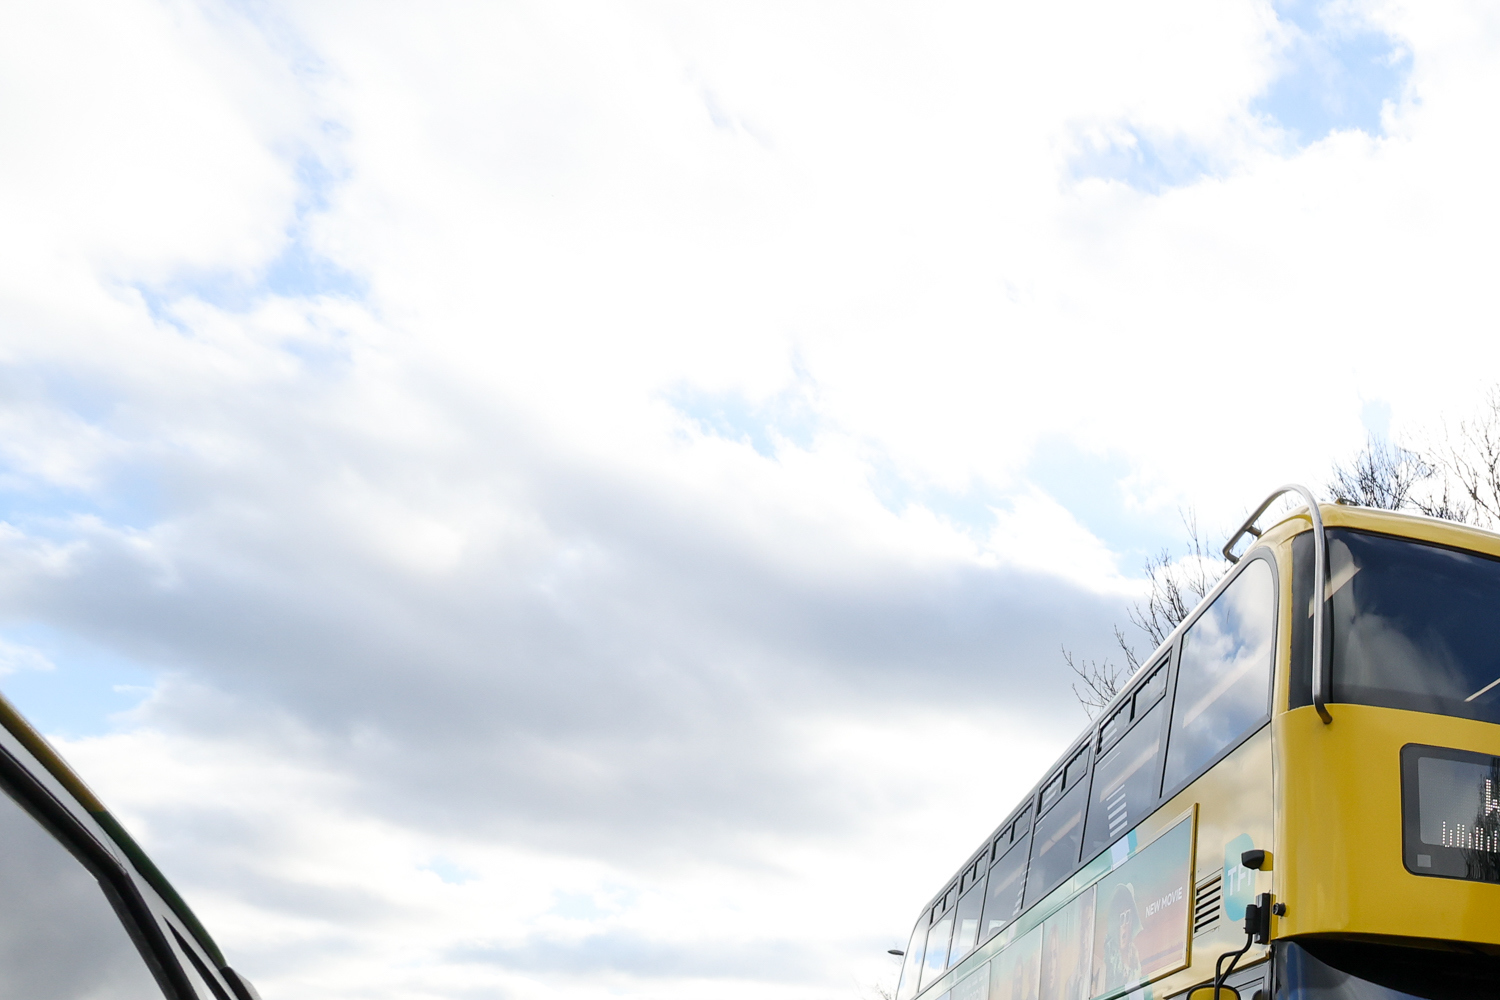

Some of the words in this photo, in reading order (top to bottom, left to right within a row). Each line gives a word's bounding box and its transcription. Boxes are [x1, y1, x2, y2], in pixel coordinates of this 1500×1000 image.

[1227, 863, 1252, 896] TFI
[1145, 900, 1162, 918] NEW
[1161, 886, 1183, 910] MOVIE
